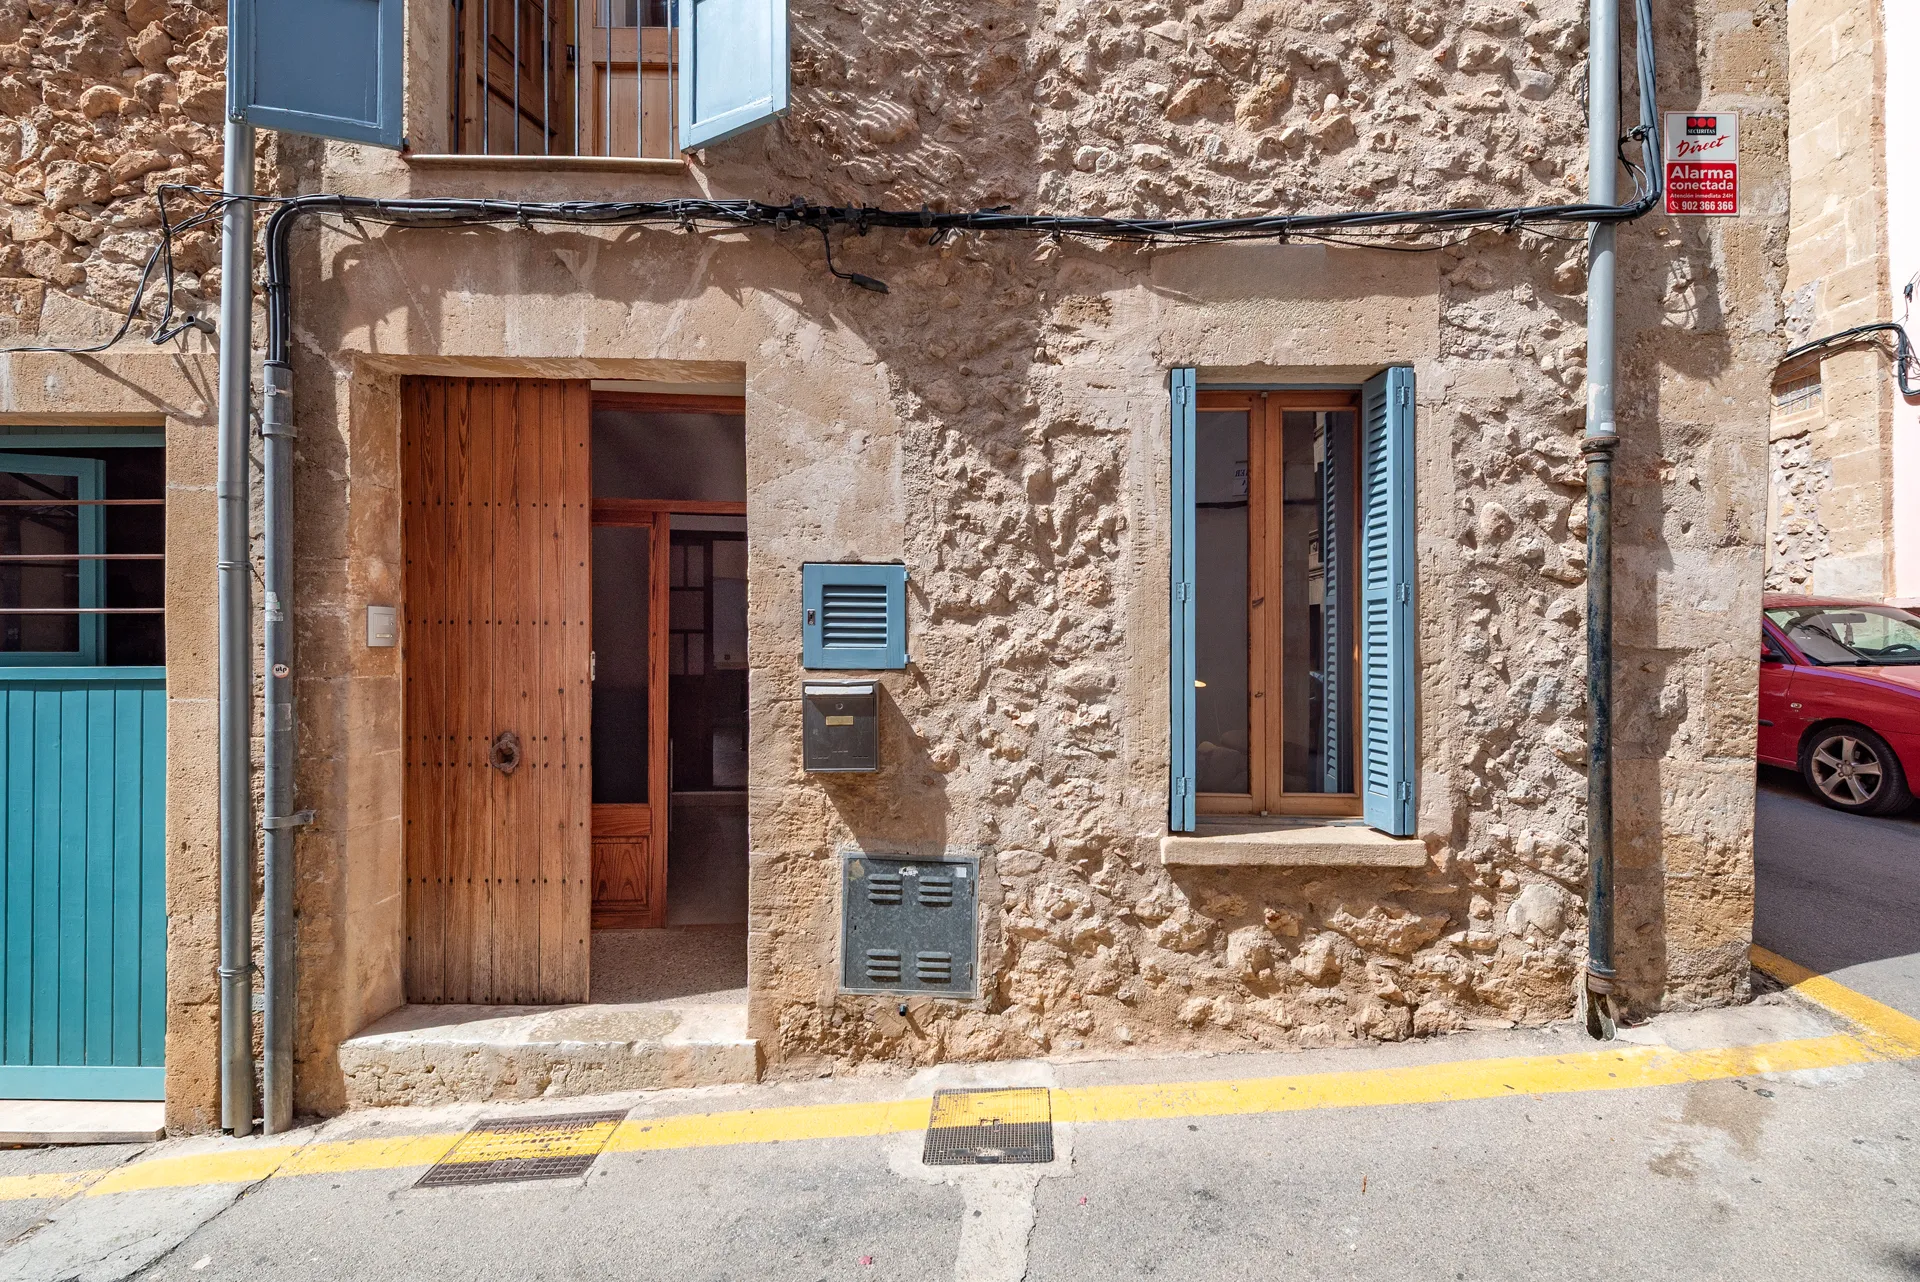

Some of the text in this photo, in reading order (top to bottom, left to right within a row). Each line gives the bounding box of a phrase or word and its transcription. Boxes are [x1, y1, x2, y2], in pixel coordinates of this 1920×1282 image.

[1676, 135, 1730, 157] Direct
[1670, 165, 1733, 179] Alarma
[1670, 180, 1733, 190] conectada
[1682, 201, 1733, 210] 902 366 366
